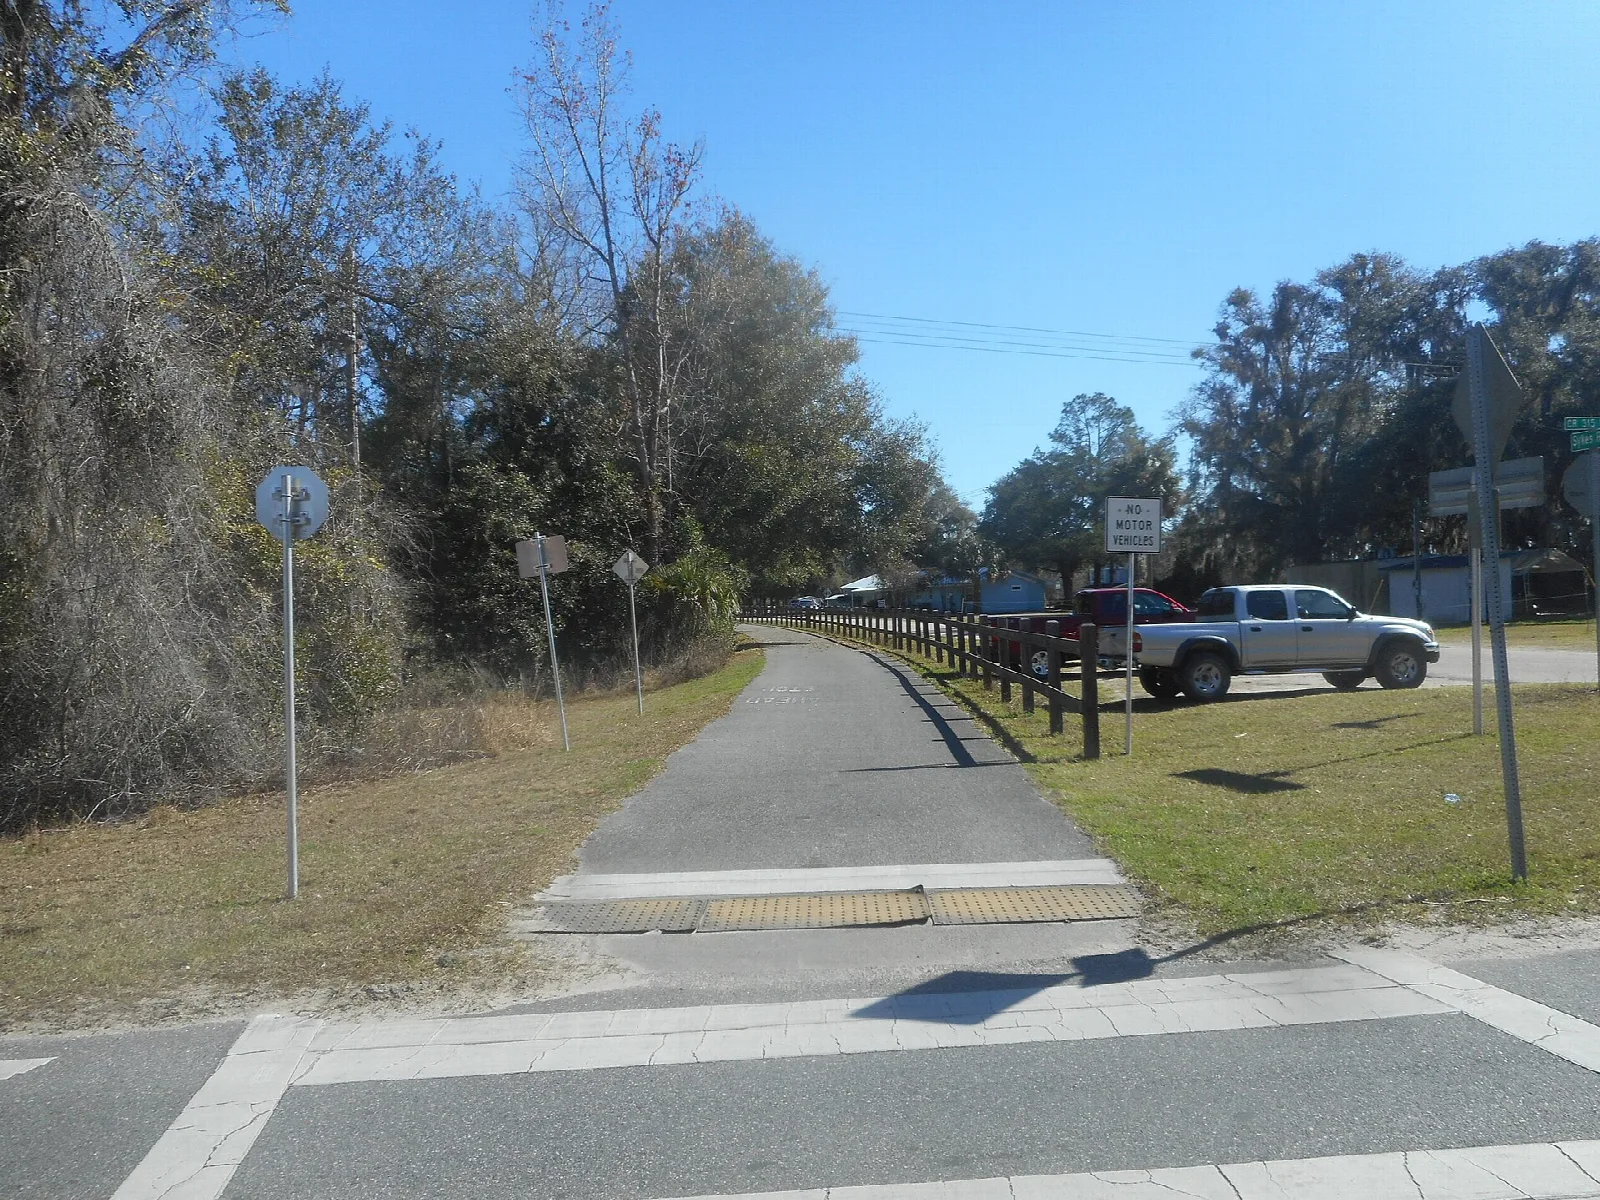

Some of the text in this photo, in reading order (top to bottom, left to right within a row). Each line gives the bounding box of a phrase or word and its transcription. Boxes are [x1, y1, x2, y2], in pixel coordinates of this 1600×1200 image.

[1127, 504, 1141, 515] NO
[1116, 519, 1152, 530] MOTOR
[1113, 534, 1154, 546] VEHICLES
